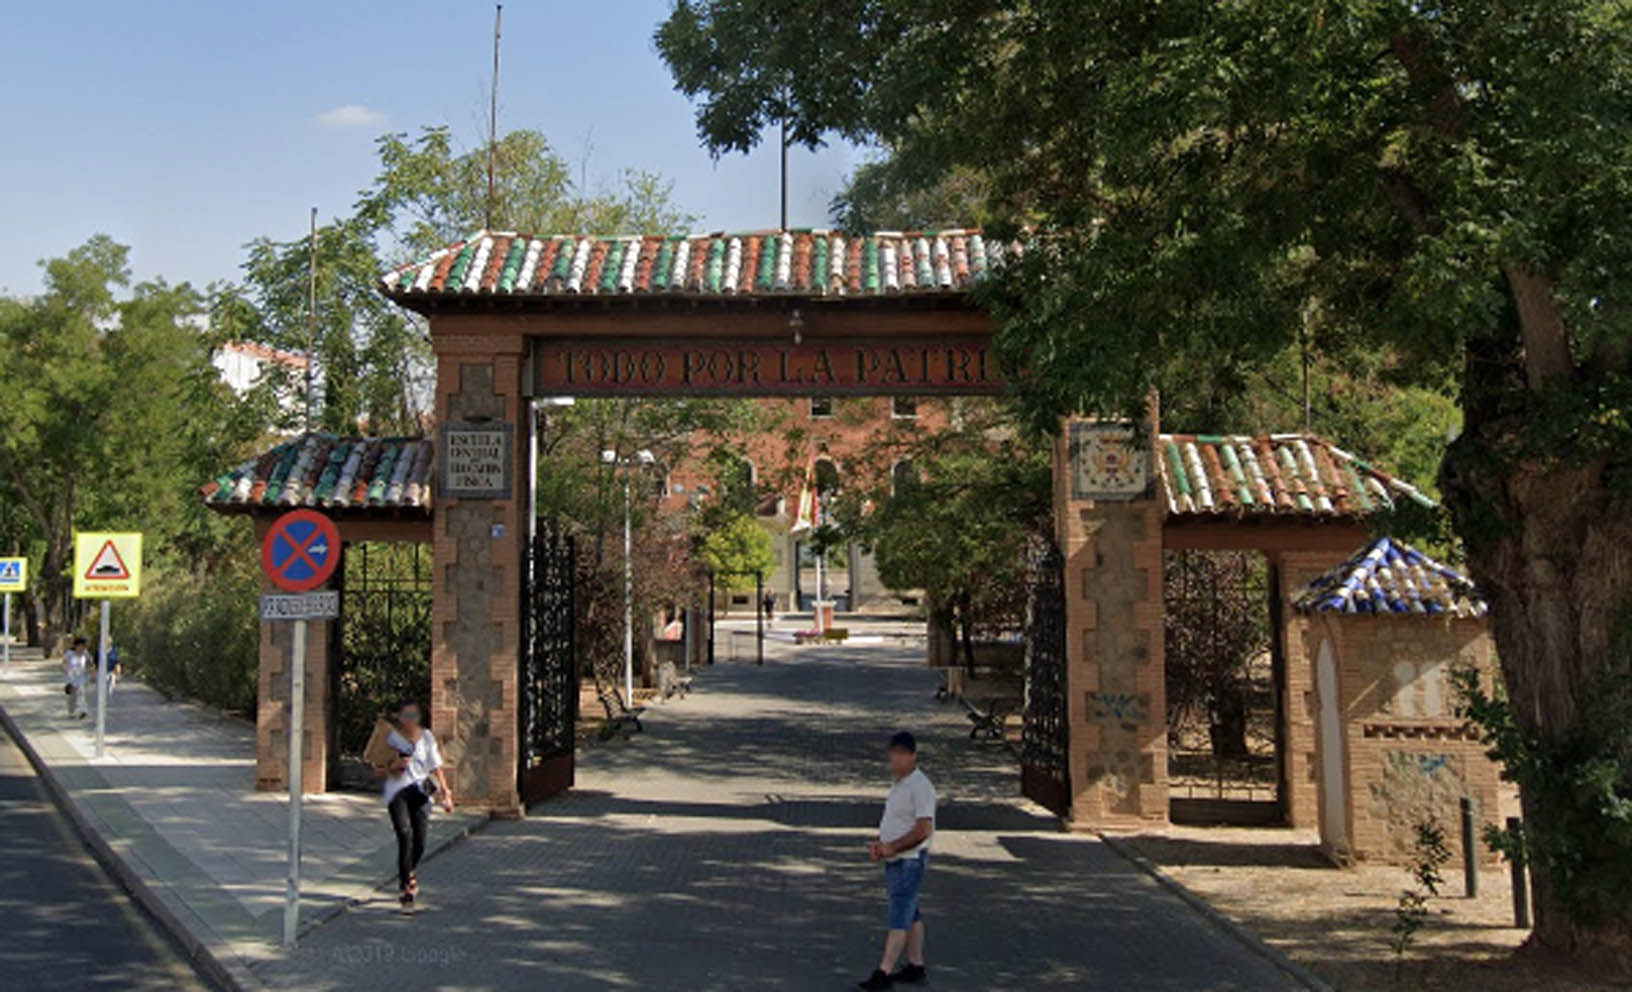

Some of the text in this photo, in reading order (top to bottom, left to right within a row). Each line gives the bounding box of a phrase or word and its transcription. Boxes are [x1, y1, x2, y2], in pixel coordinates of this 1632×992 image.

[558, 349, 989, 384] TODO POR LA PATRI
